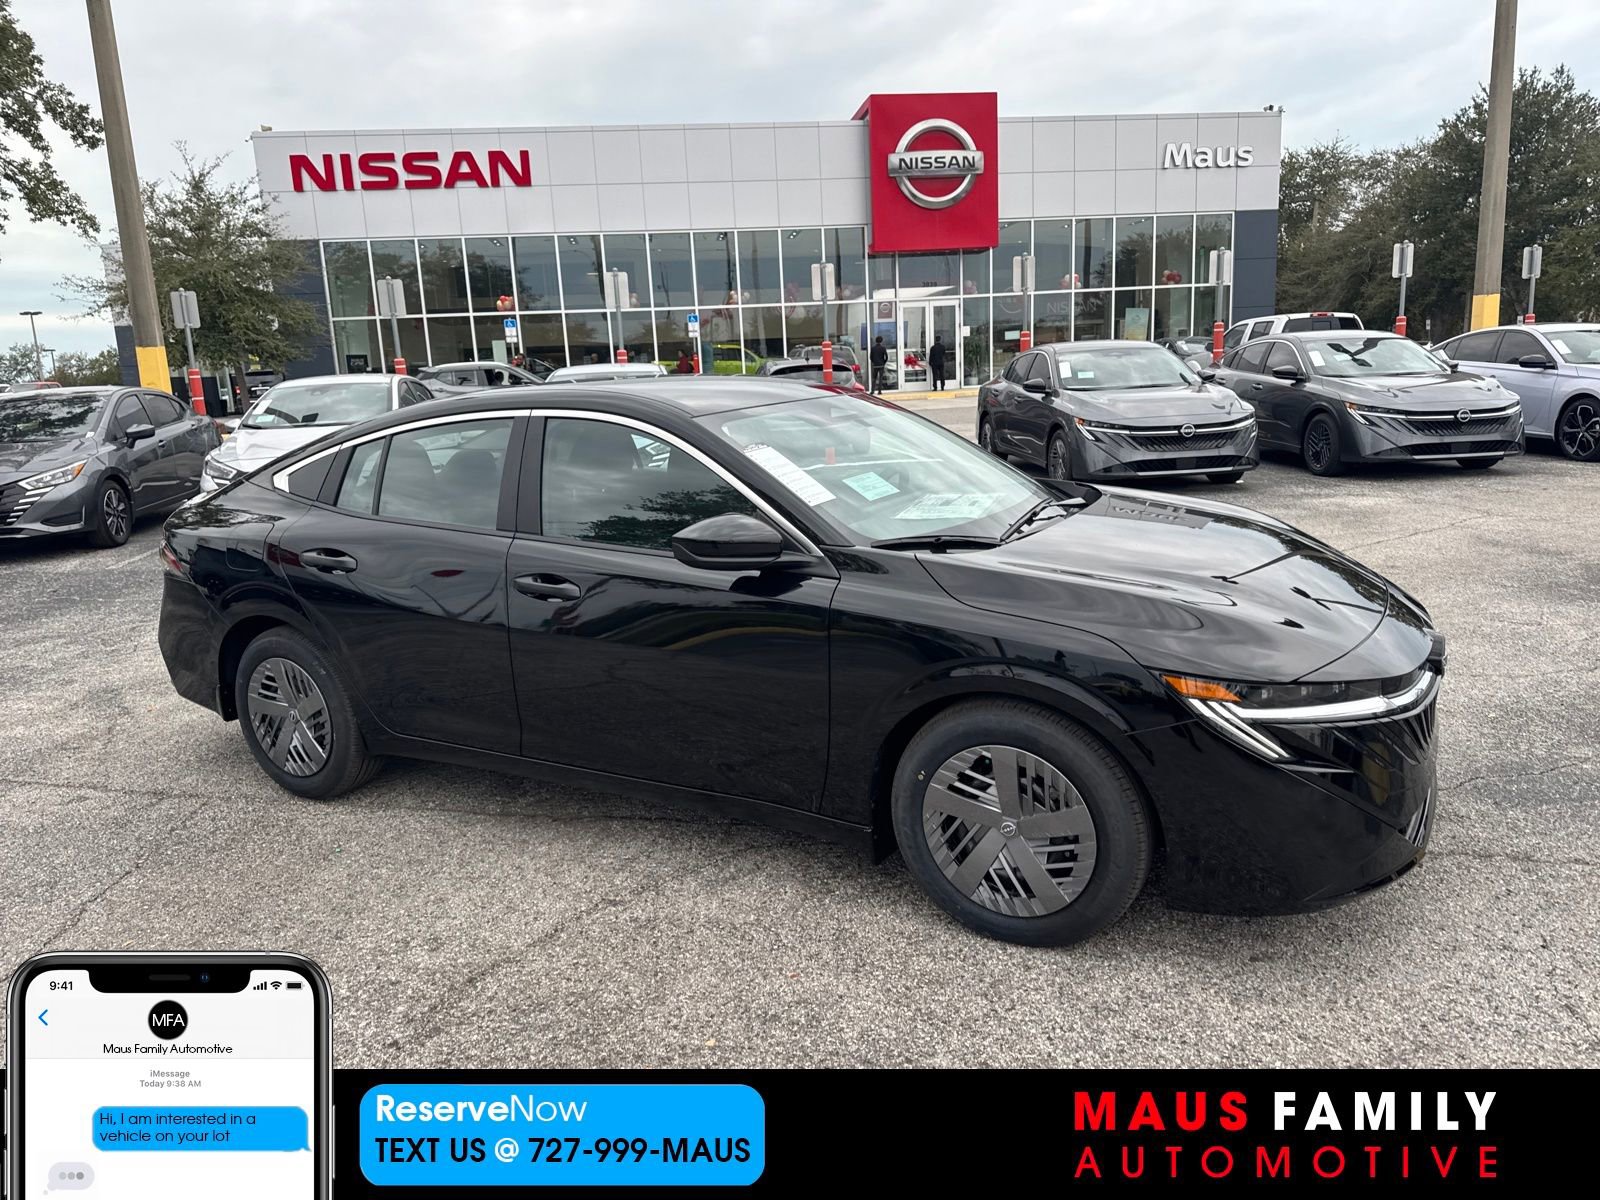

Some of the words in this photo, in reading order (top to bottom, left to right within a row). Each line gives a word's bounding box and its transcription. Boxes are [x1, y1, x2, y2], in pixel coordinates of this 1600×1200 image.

[898, 154, 977, 172] NISSAN
[1163, 142, 1254, 168] Maus
[289, 150, 532, 192] NISSAN
